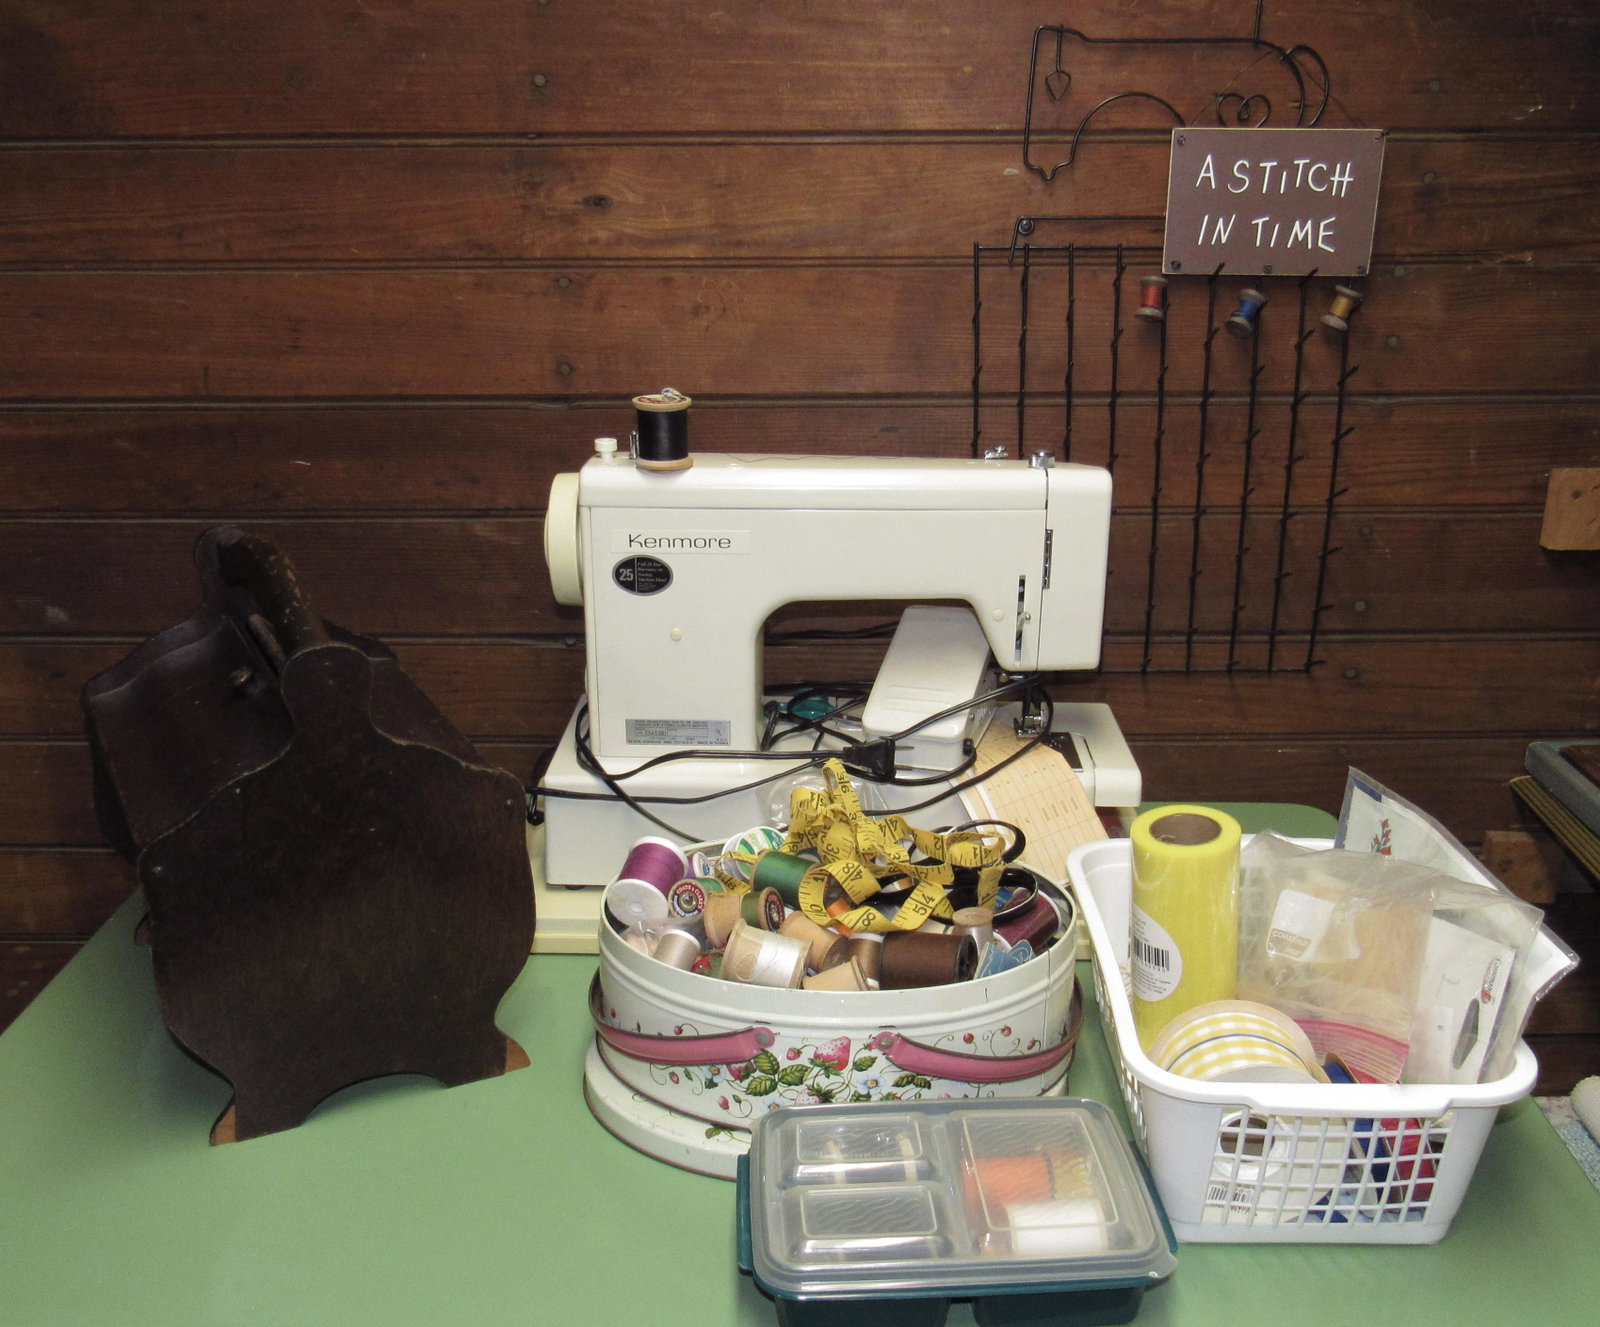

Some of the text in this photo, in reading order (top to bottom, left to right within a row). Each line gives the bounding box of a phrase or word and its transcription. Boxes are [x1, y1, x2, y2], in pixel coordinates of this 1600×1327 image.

[1195, 153, 1354, 198] A STITCH
[1198, 213, 1336, 253] IN TIME
[628, 533, 732, 549] Kenmore
[619, 568, 634, 581] 25
